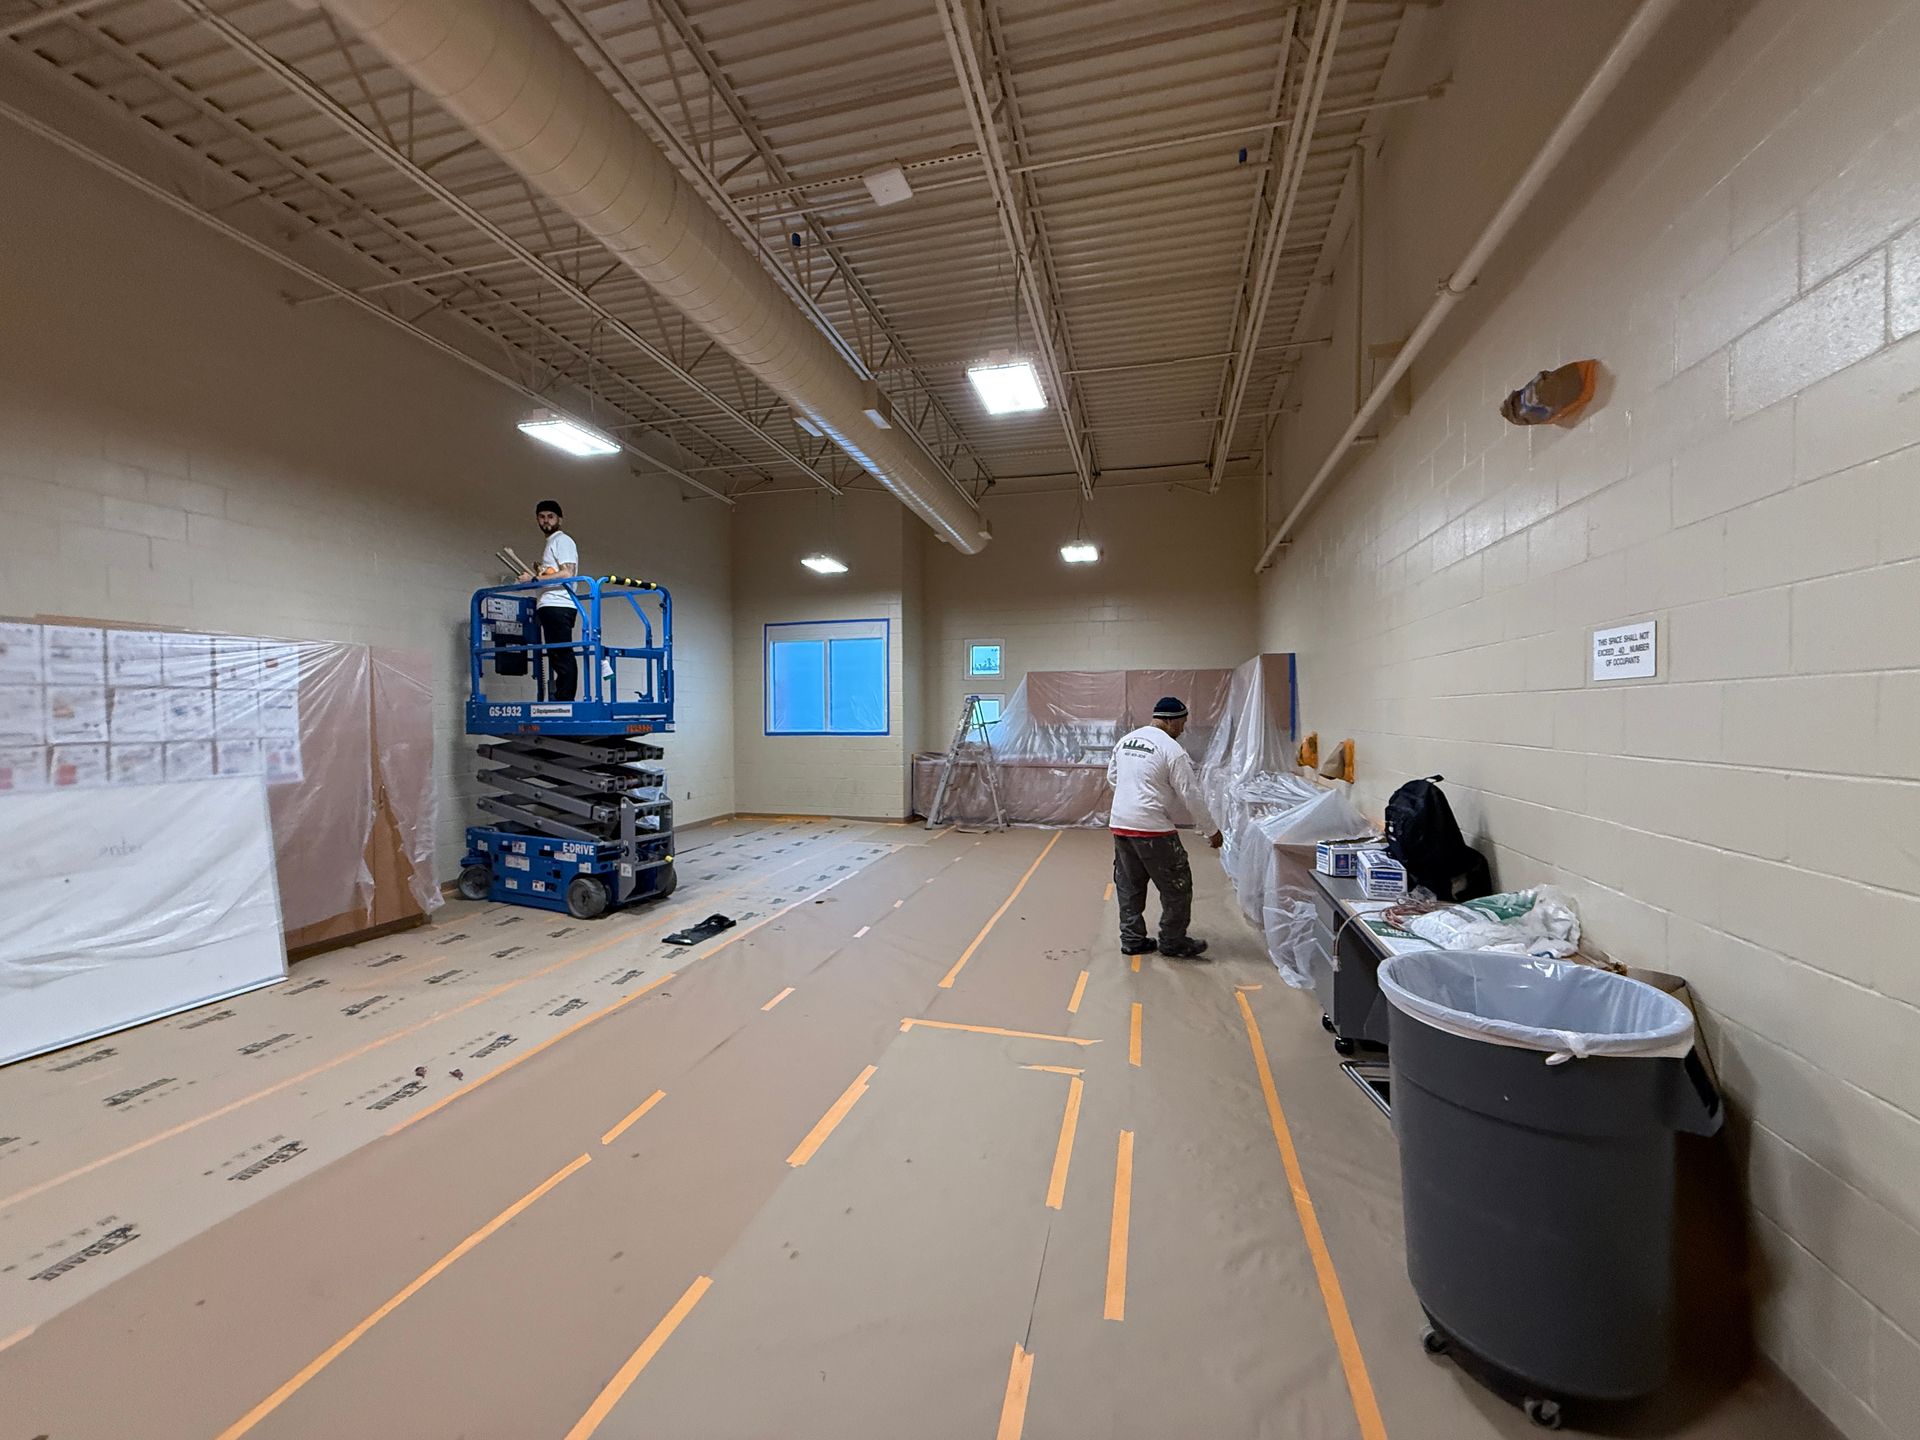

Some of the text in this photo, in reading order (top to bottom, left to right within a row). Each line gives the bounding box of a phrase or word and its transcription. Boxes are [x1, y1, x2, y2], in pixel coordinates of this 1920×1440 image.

[1609, 636, 1622, 645] SPACE
[1624, 633, 1638, 642] SHALL
[1639, 631, 1649, 640] NOT
[1598, 648, 1614, 657] EXCEED
[1630, 643, 1649, 652] NUMBER
[1613, 656, 1640, 665] OCCUPANTS
[489, 706, 522, 717] GS-1932
[562, 842, 595, 856] E-DRIVE
